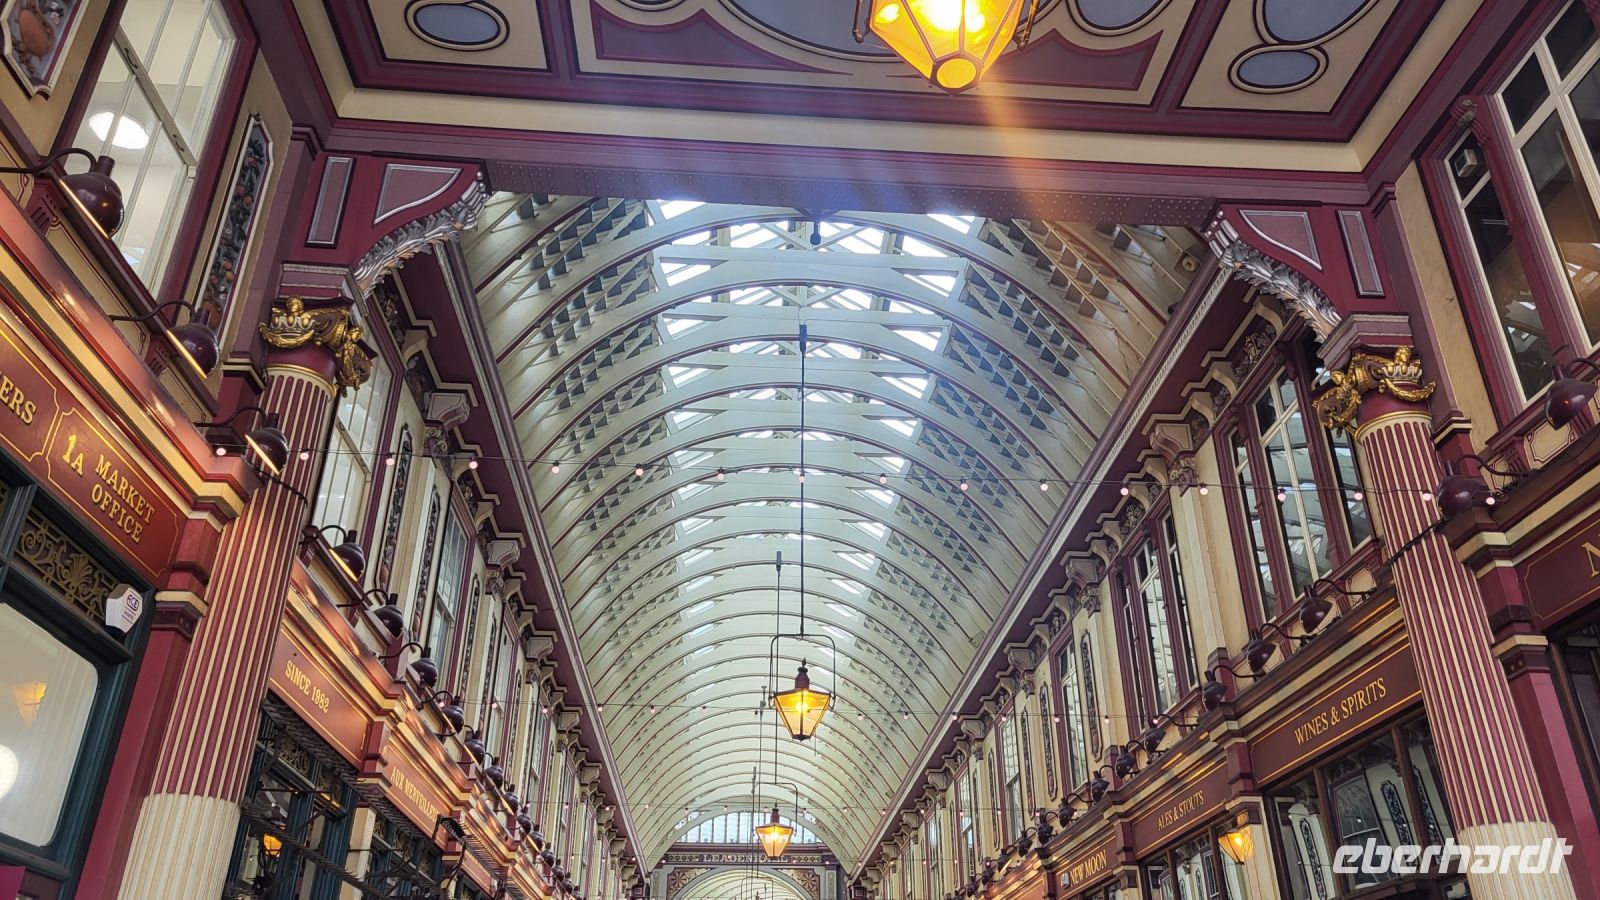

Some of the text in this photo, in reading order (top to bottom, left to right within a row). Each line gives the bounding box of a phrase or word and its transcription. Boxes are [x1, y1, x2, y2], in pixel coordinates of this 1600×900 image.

[0, 373, 36, 424] ERS
[62, 434, 84, 476] 1A
[95, 454, 155, 524] MARKET
[91, 484, 143, 543] OFFICE
[285, 660, 311, 696] SINCE
[1294, 677, 1387, 745] WINES & SPIRITS
[1158, 790, 1204, 831] ALES & STOUTS
[1070, 850, 1108, 887] NEW MOON
